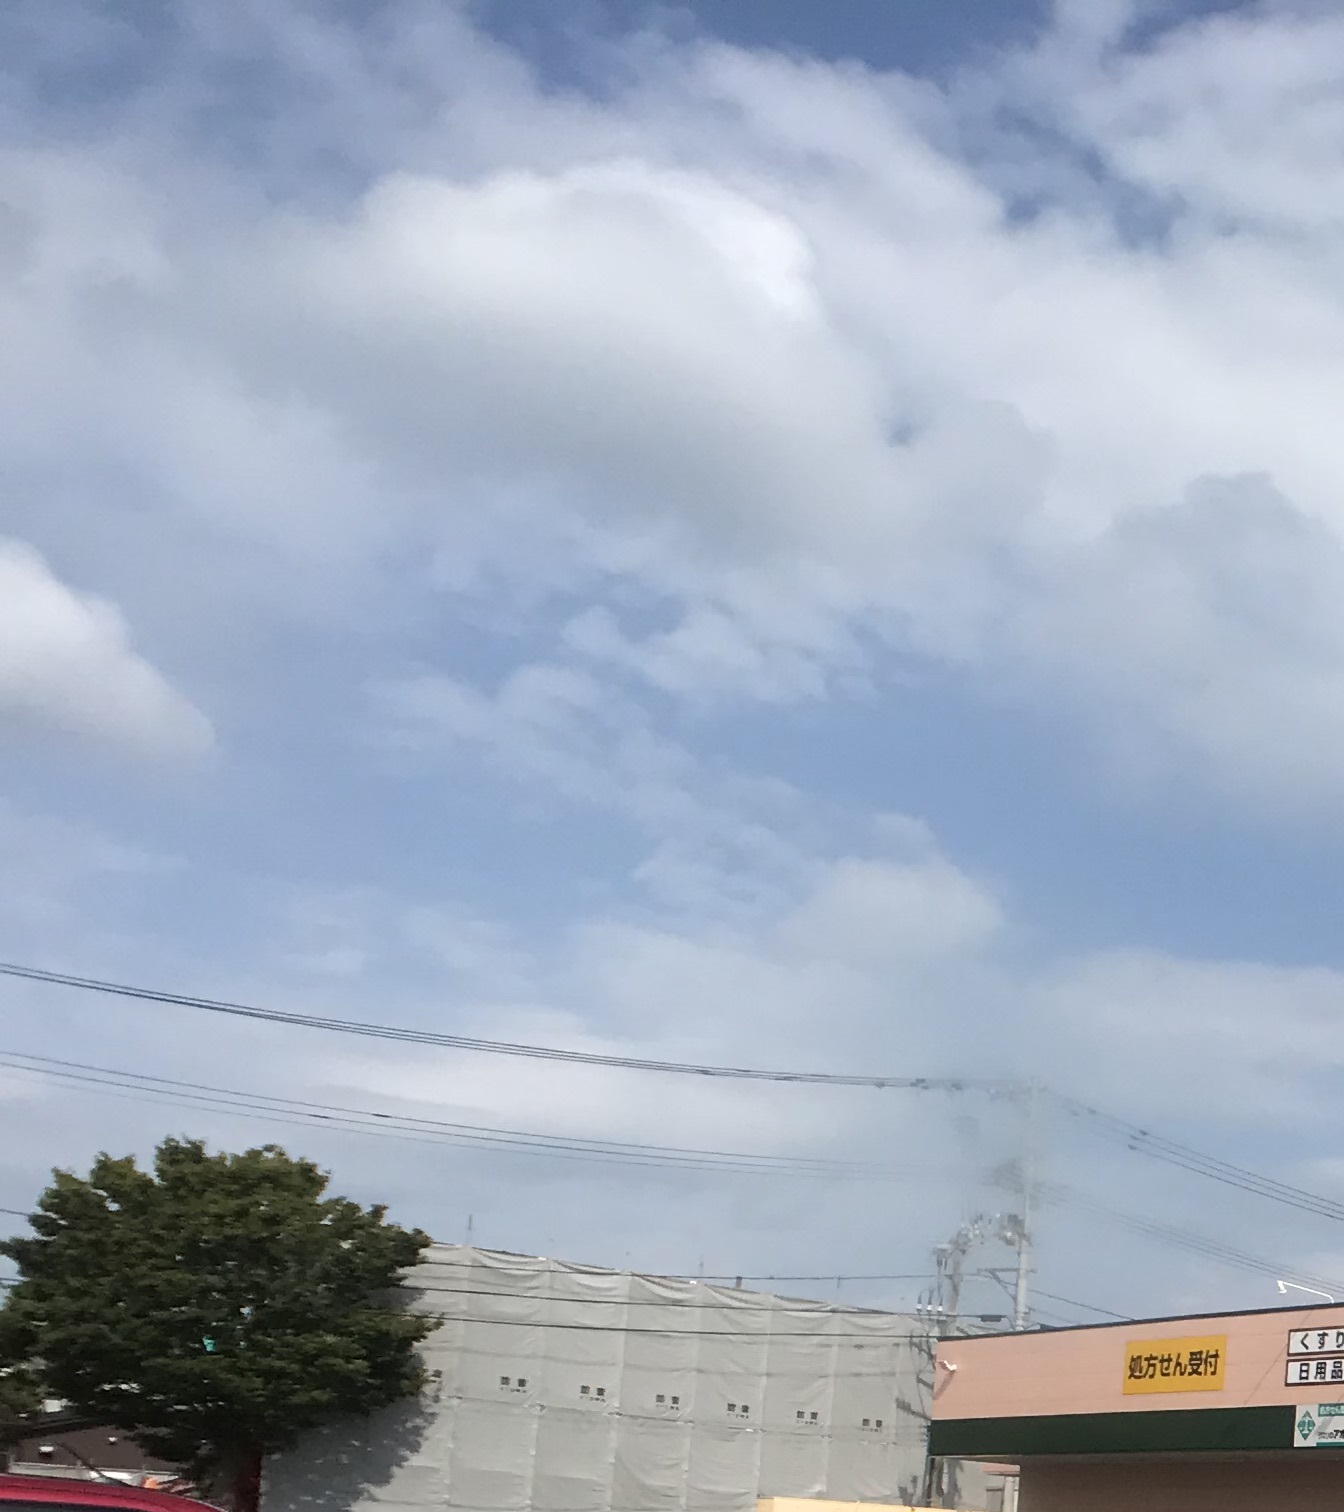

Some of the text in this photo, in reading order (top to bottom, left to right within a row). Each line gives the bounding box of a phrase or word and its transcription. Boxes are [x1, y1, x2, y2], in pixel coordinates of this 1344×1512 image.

[1128, 1349, 1220, 1380] 処方せん受付
[1298, 1360, 1344, 1381] 日用品
